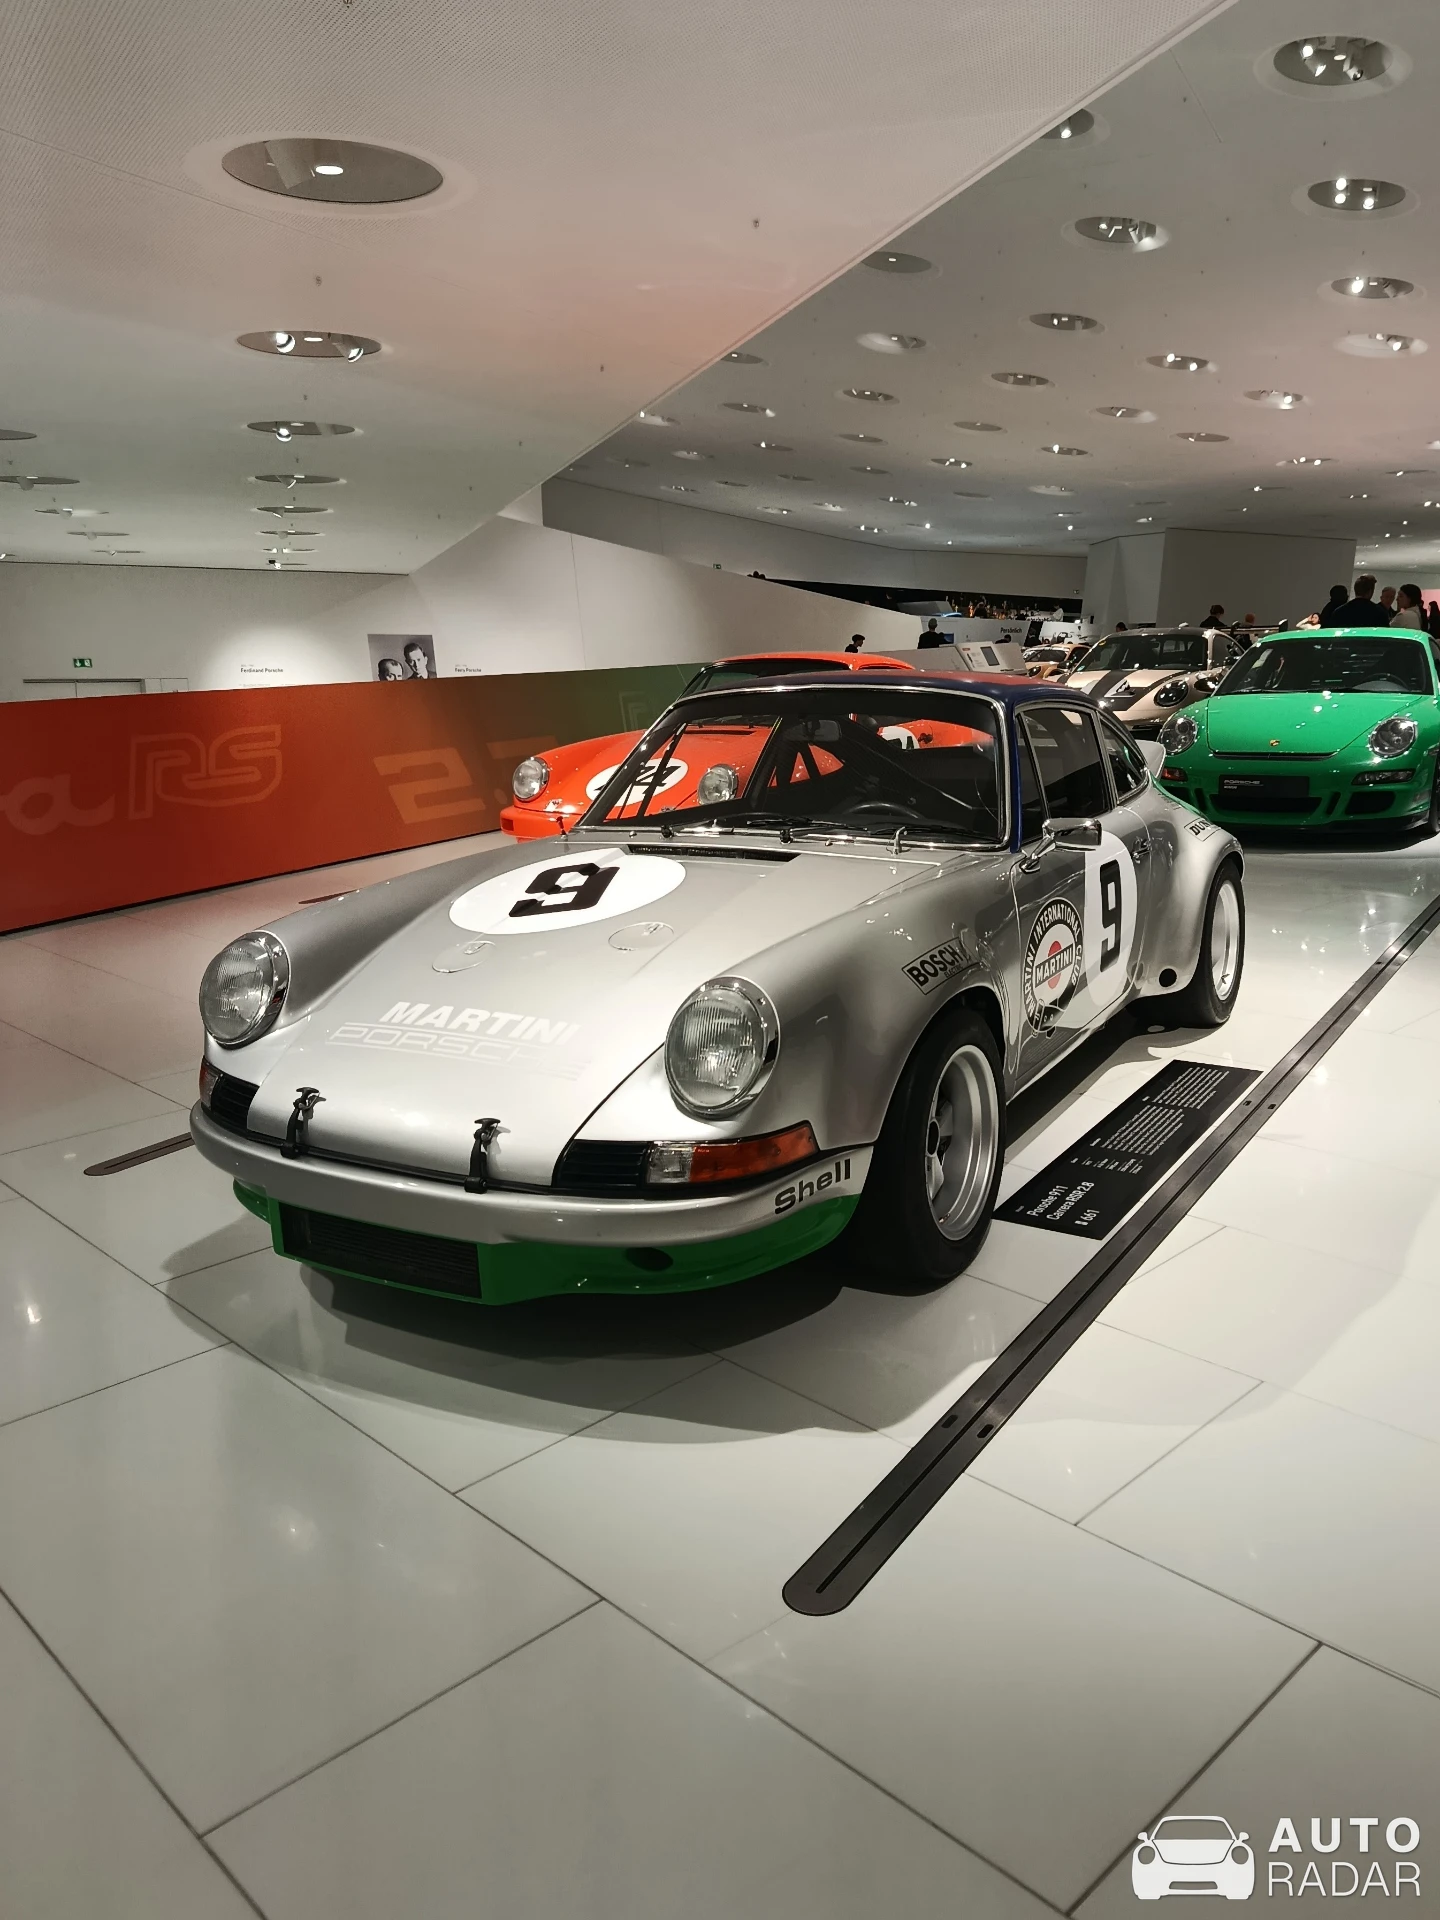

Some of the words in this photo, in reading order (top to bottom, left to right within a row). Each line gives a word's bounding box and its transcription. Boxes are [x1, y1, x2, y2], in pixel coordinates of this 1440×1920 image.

[129, 724, 283, 820] RS
[509, 863, 620, 917] 9
[1100, 859, 1122, 973] 9
[906, 944, 964, 987] BOSCH
[1024, 943, 1037, 1017] MARTINI
[1033, 903, 1081, 943] INTERNATIONAL
[1071, 944, 1082, 986] CLUB
[1036, 947, 1073, 984] MARTINI
[378, 1001, 582, 1046] MARTINI
[774, 1158, 851, 1215] Shell
[1026, 1195, 1058, 1217] Porsche
[1048, 1185, 1069, 1196] 911
[1046, 1201, 1075, 1220] Carrera
[1065, 1190, 1087, 1202] RSR
[1080, 1209, 1100, 1221] 661
